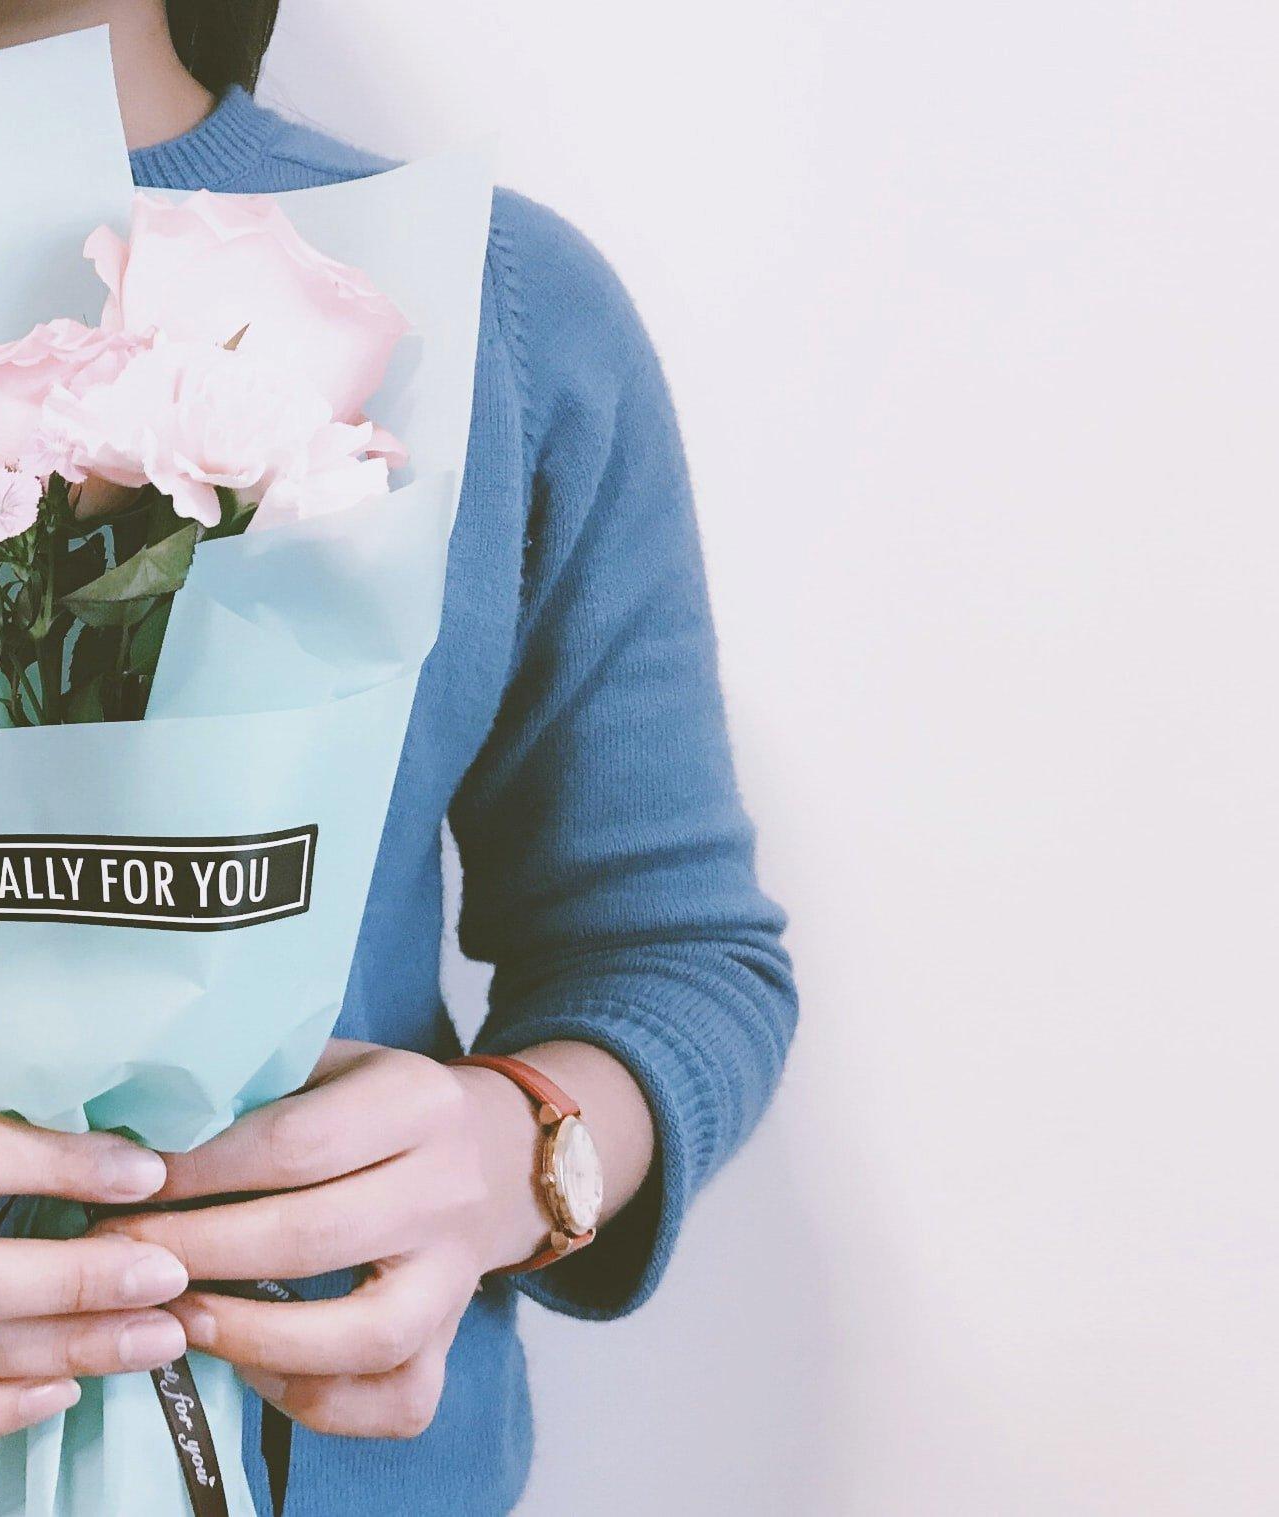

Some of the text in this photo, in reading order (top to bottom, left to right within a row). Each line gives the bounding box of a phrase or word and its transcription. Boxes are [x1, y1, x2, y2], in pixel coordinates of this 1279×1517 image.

[100, 858, 177, 907] FOR
[190, 857, 269, 908] YOU
[159, 1379, 195, 1432] for
